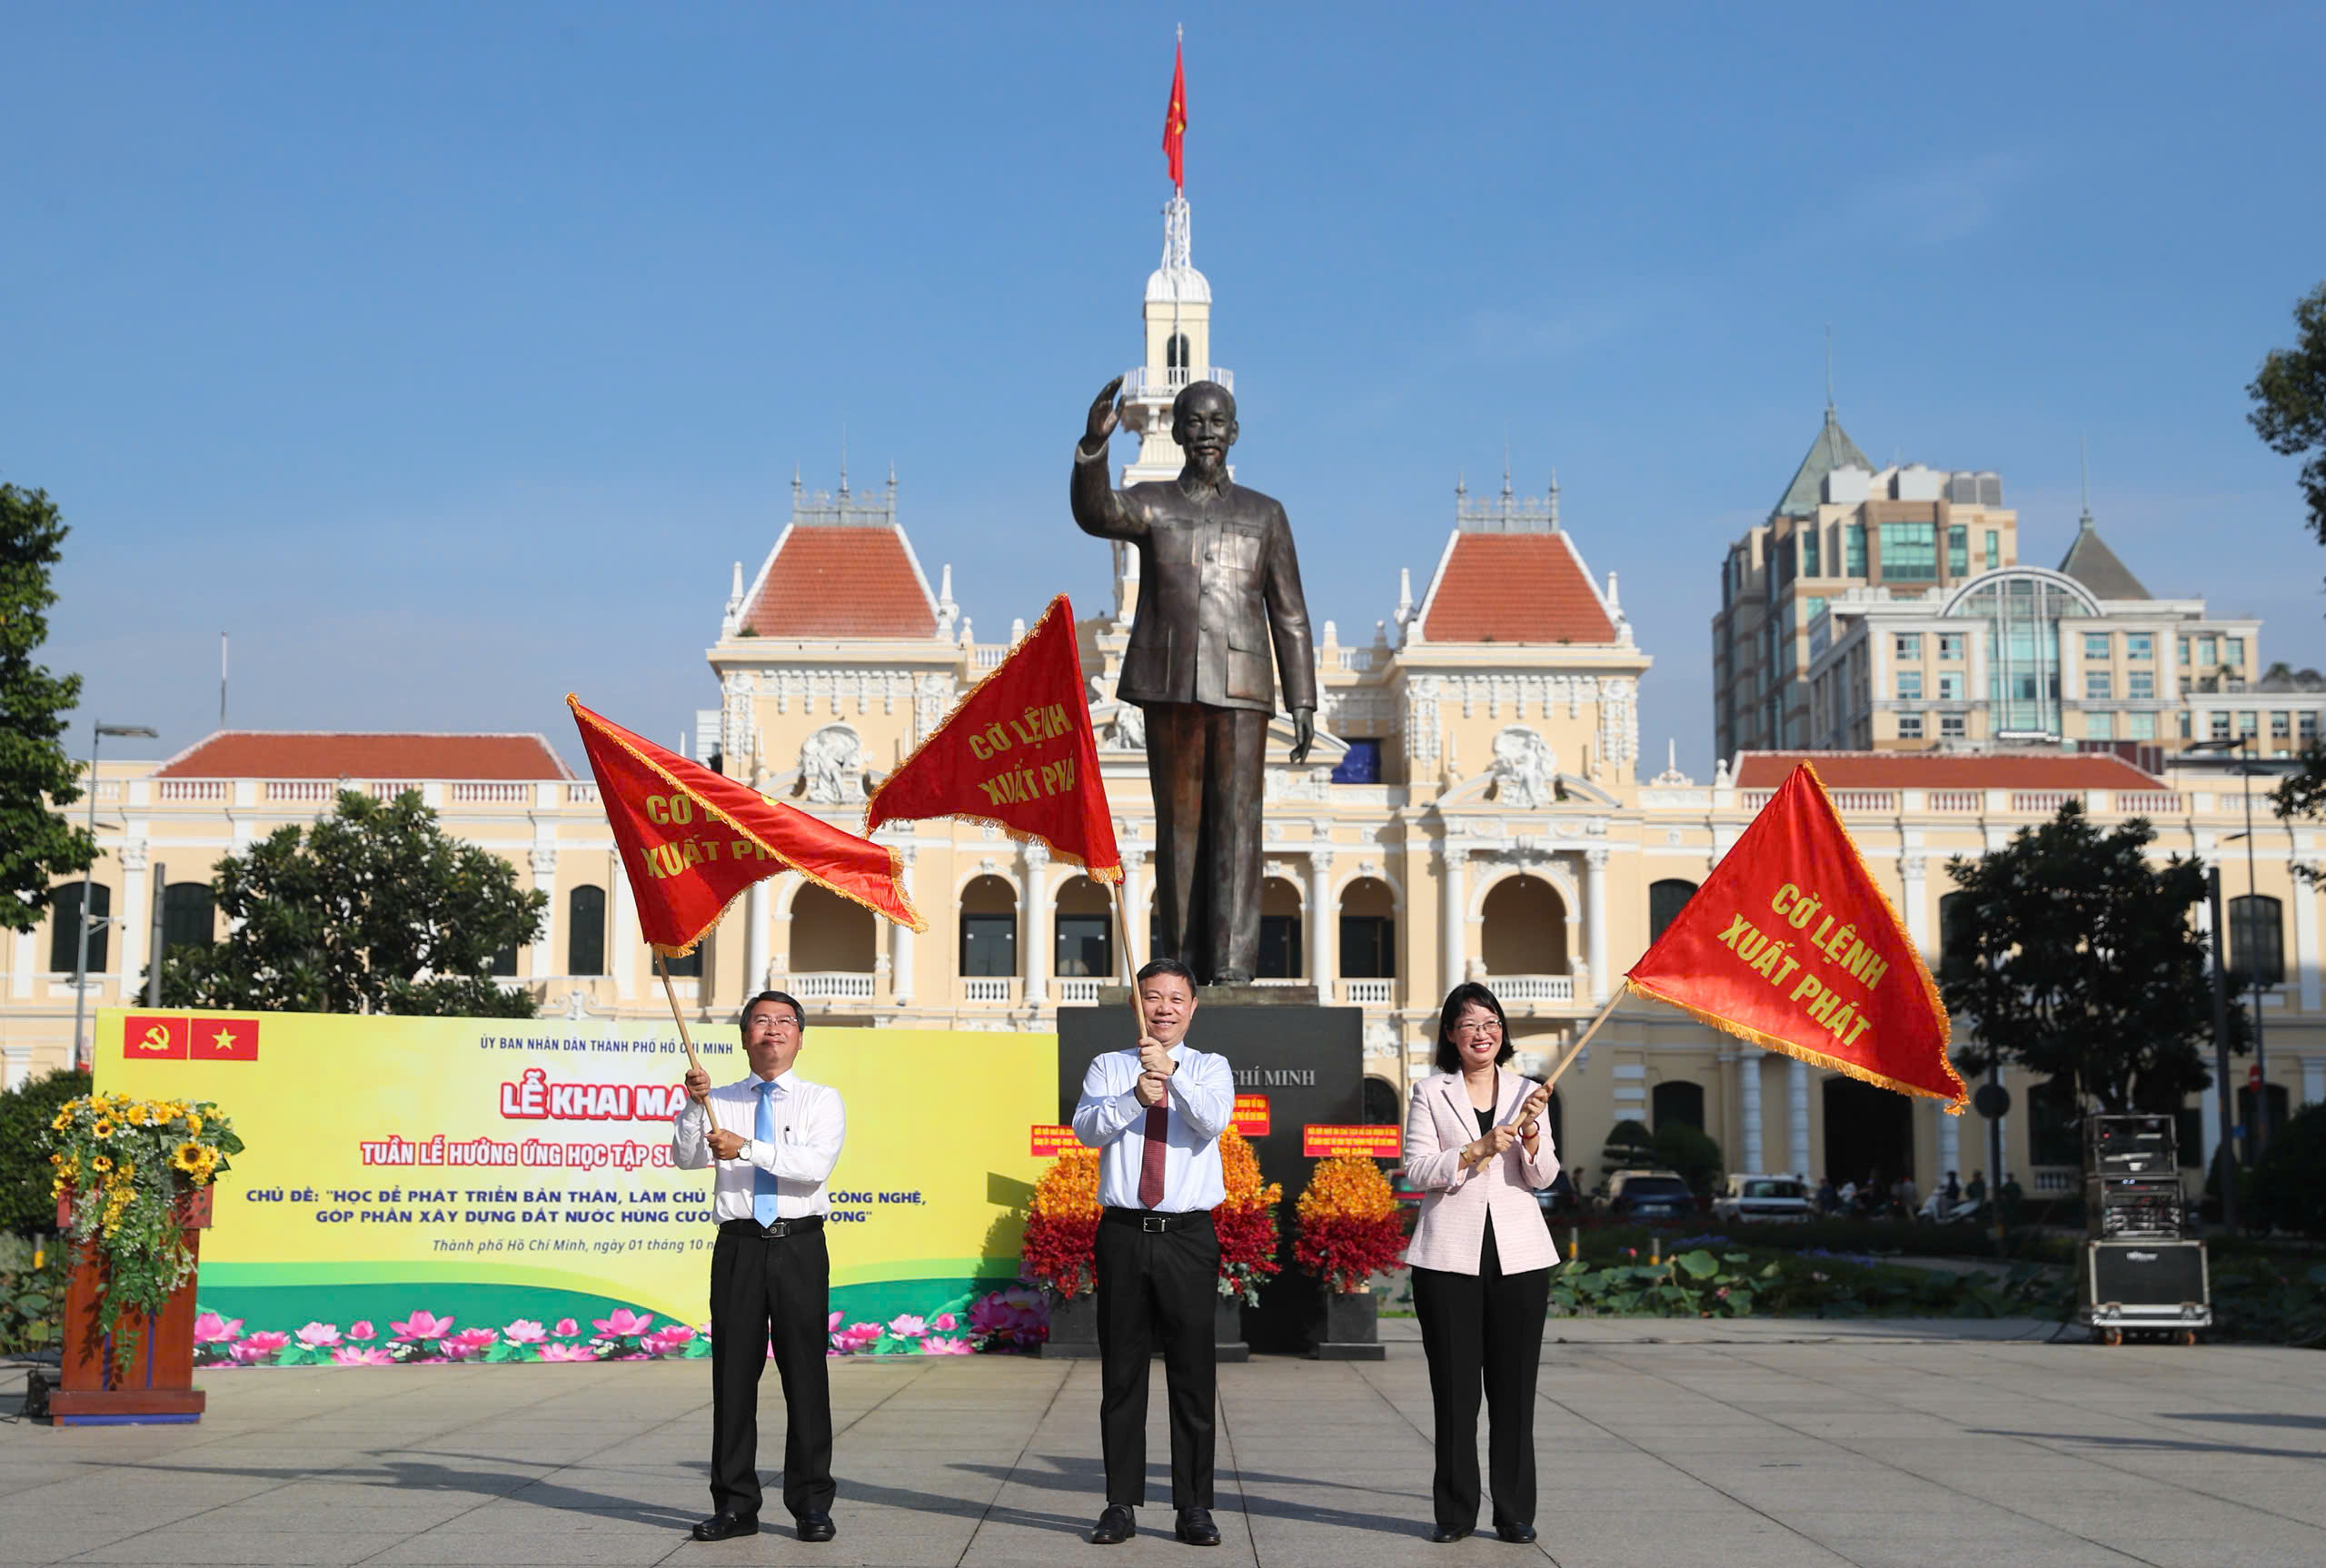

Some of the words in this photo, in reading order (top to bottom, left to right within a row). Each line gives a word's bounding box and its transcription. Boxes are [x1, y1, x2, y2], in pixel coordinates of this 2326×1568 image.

[969, 722, 1012, 760] CỜ
[640, 834, 721, 878] XUẤT
[1772, 883, 1823, 929] CỜ
[1810, 914, 1889, 991] LỆNH
[1716, 913, 1801, 987] XUẤT
[1789, 973, 1872, 1047] PHÁT
[500, 1037, 522, 1049] BAN
[527, 1036, 559, 1050] NHÂN
[563, 1036, 586, 1051] DÂN
[591, 1036, 628, 1052] THÀNH
[632, 1038, 656, 1053] PHỐ
[703, 1043, 733, 1054] MINH
[501, 1068, 548, 1118] LỄ
[551, 1084, 632, 1120] KHAI
[1264, 1069, 1316, 1086] MINH
[361, 1135, 415, 1166] TUẦN
[419, 1135, 445, 1166] LỄ
[447, 1136, 518, 1166] HƯỞNG
[522, 1138, 562, 1166] ỨNG
[566, 1143, 608, 1171] HỌC
[611, 1139, 649, 1171] TẬP
[246, 1186, 283, 1202] CHỦ
[408, 1188, 458, 1203] PHÁT
[465, 1186, 517, 1203] TRIỂN
[523, 1187, 562, 1203] BẢN
[568, 1188, 621, 1205] THÂN,
[629, 1188, 666, 1203] LÀM
[672, 1187, 706, 1203] CHỦ
[829, 1190, 873, 1203] CÔNG
[315, 1208, 353, 1223] GÓP
[361, 1206, 413, 1223] PHẦN
[419, 1208, 458, 1223] XÂY
[465, 1209, 515, 1224] DỰNG
[565, 1208, 615, 1223] NƯỚC
[621, 1208, 669, 1223] HÙNG
[433, 1239, 473, 1251] Thành
[477, 1239, 503, 1255] phố
[507, 1239, 524, 1251] Hồ
[529, 1239, 550, 1251] Chí
[553, 1239, 589, 1254] Minh,
[593, 1240, 625, 1254] ngày
[628, 1239, 642, 1251] 01
[647, 1239, 684, 1254] tháng
[690, 1239, 703, 1251] 10
